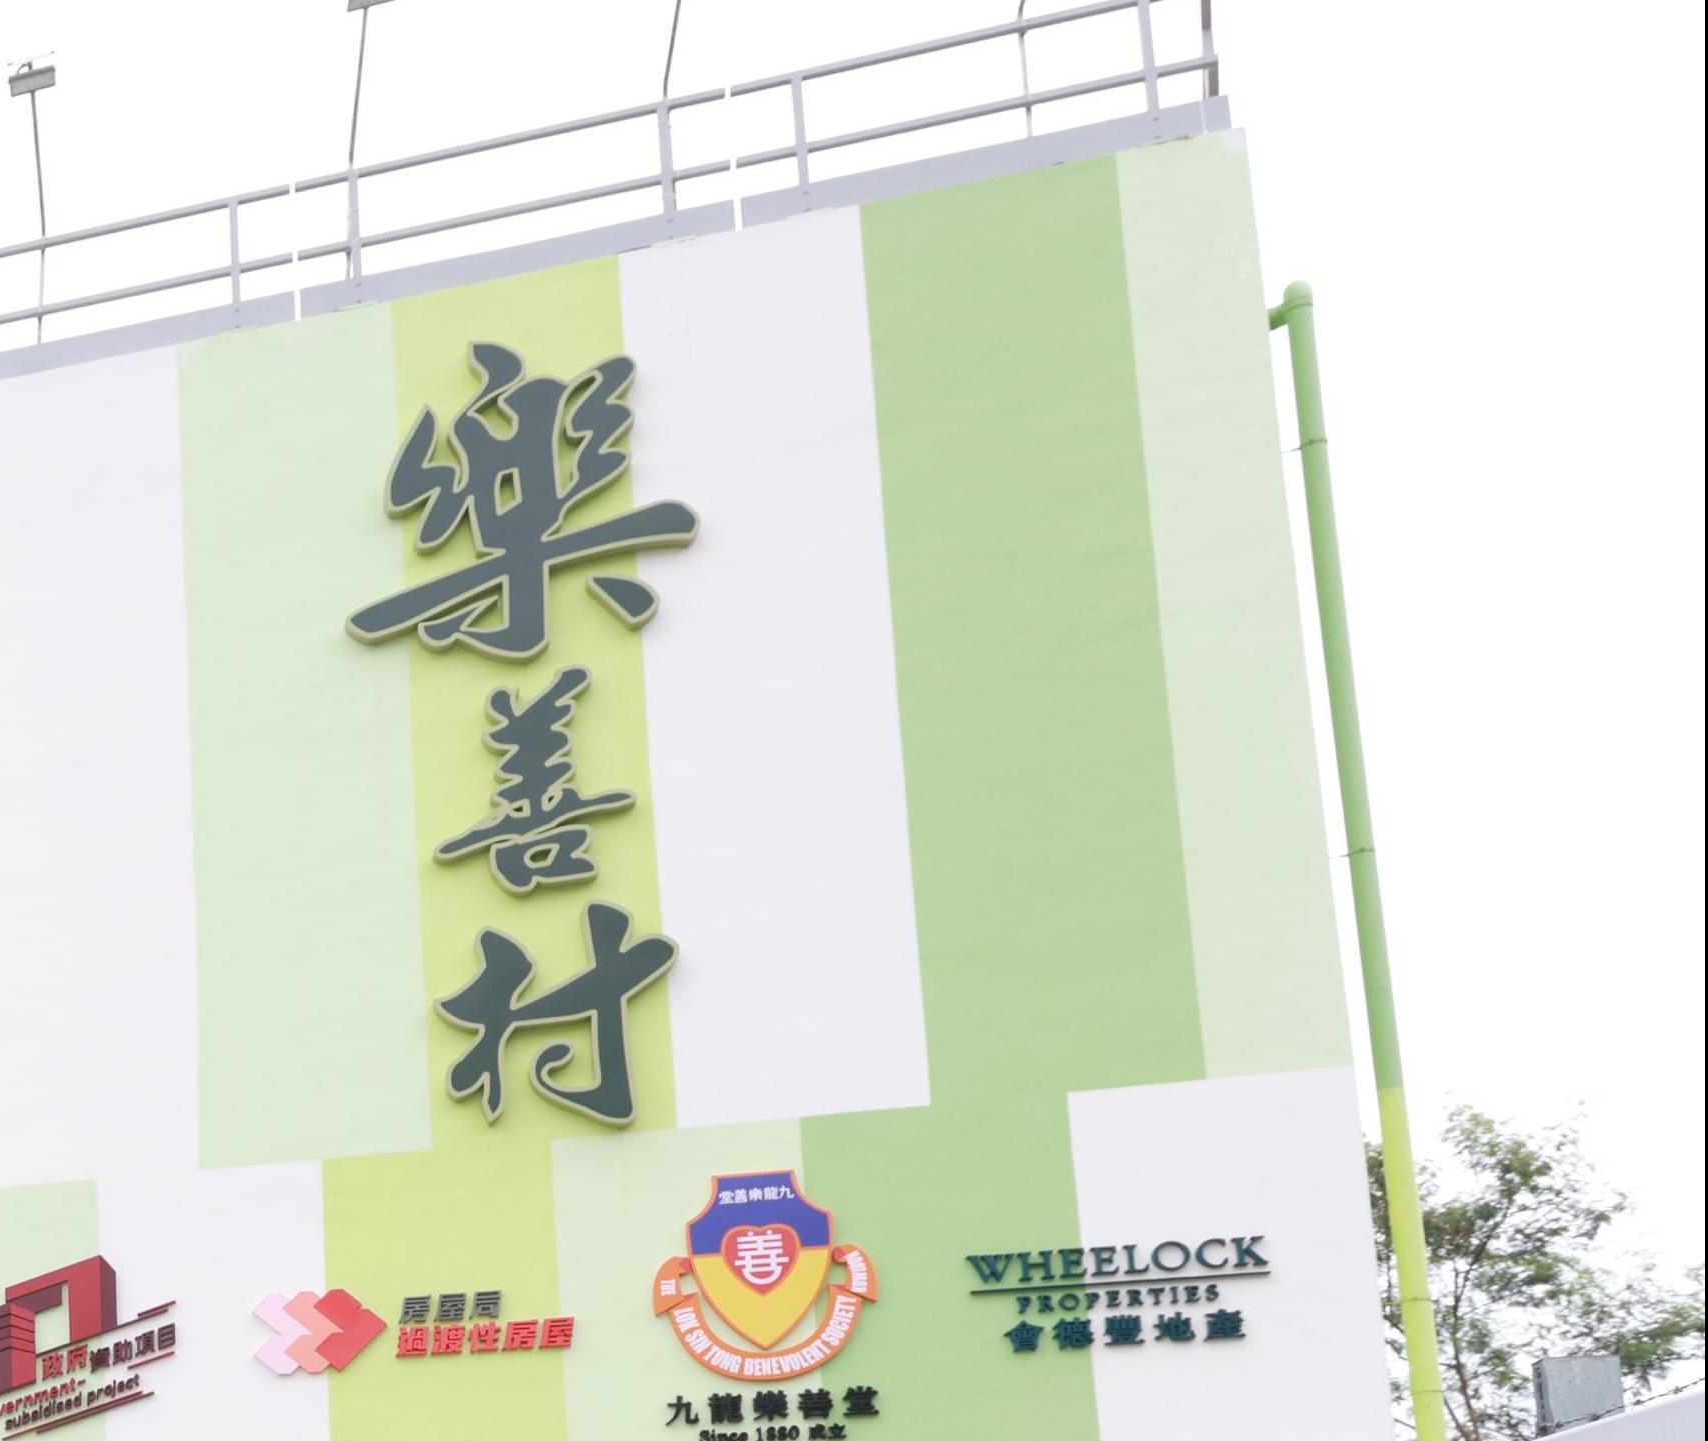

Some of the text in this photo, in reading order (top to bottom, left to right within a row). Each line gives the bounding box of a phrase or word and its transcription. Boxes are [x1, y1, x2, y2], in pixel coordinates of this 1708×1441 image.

[345, 340, 700, 1126] 樂善村
[965, 1235, 1269, 1283] WHEELOCK
[399, 1290, 501, 1323] 房屋局
[1016, 1284, 1219, 1314] PROPERTIES
[396, 1316, 575, 1358] 過渡性房屋
[1004, 1308, 1246, 1353] 會德豐地產
[5, 1374, 140, 1430] subsidised project
[666, 1385, 879, 1425] 九龍樂善堂
[808, 1424, 846, 1440] 成立
